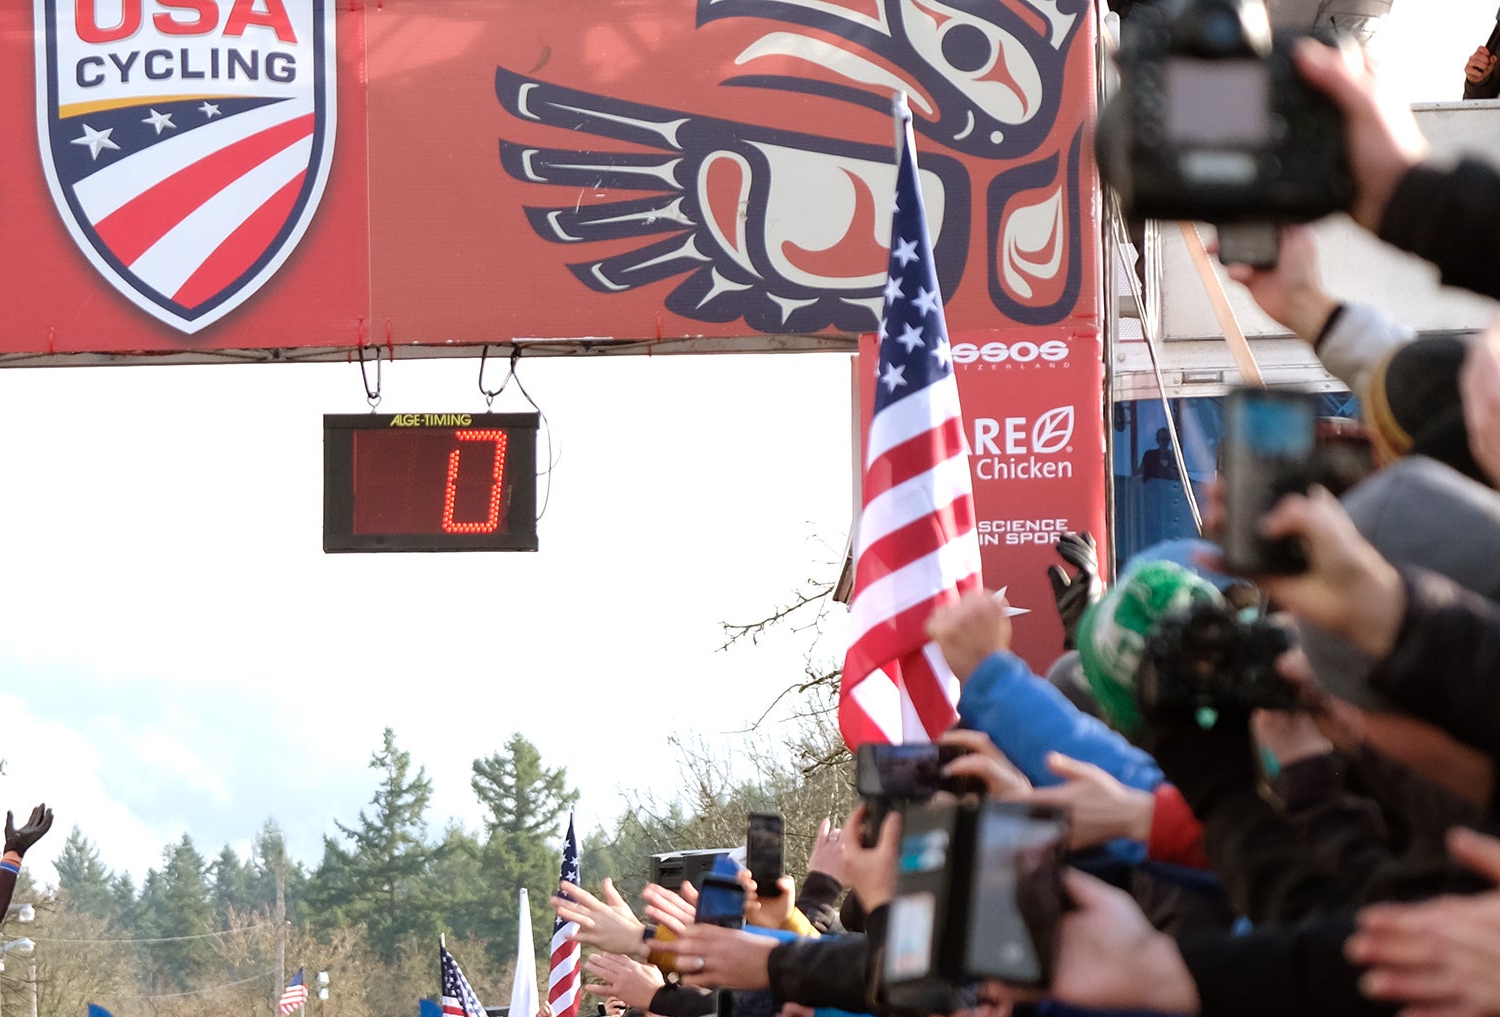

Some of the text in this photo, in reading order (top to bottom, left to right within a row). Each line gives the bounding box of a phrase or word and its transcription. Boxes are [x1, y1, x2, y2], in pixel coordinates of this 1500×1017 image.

[73, 0, 299, 46] USA
[74, 48, 298, 89] CYCLING
[951, 340, 1070, 364] SSOS
[963, 362, 1070, 370] TZERLAND
[390, 414, 473, 427] ALGE-TIMING
[968, 416, 1028, 456] RE
[976, 456, 1073, 480] Chicken
[978, 518, 1069, 533] SCIENCE
[979, 531, 1077, 545] IN SPOR
